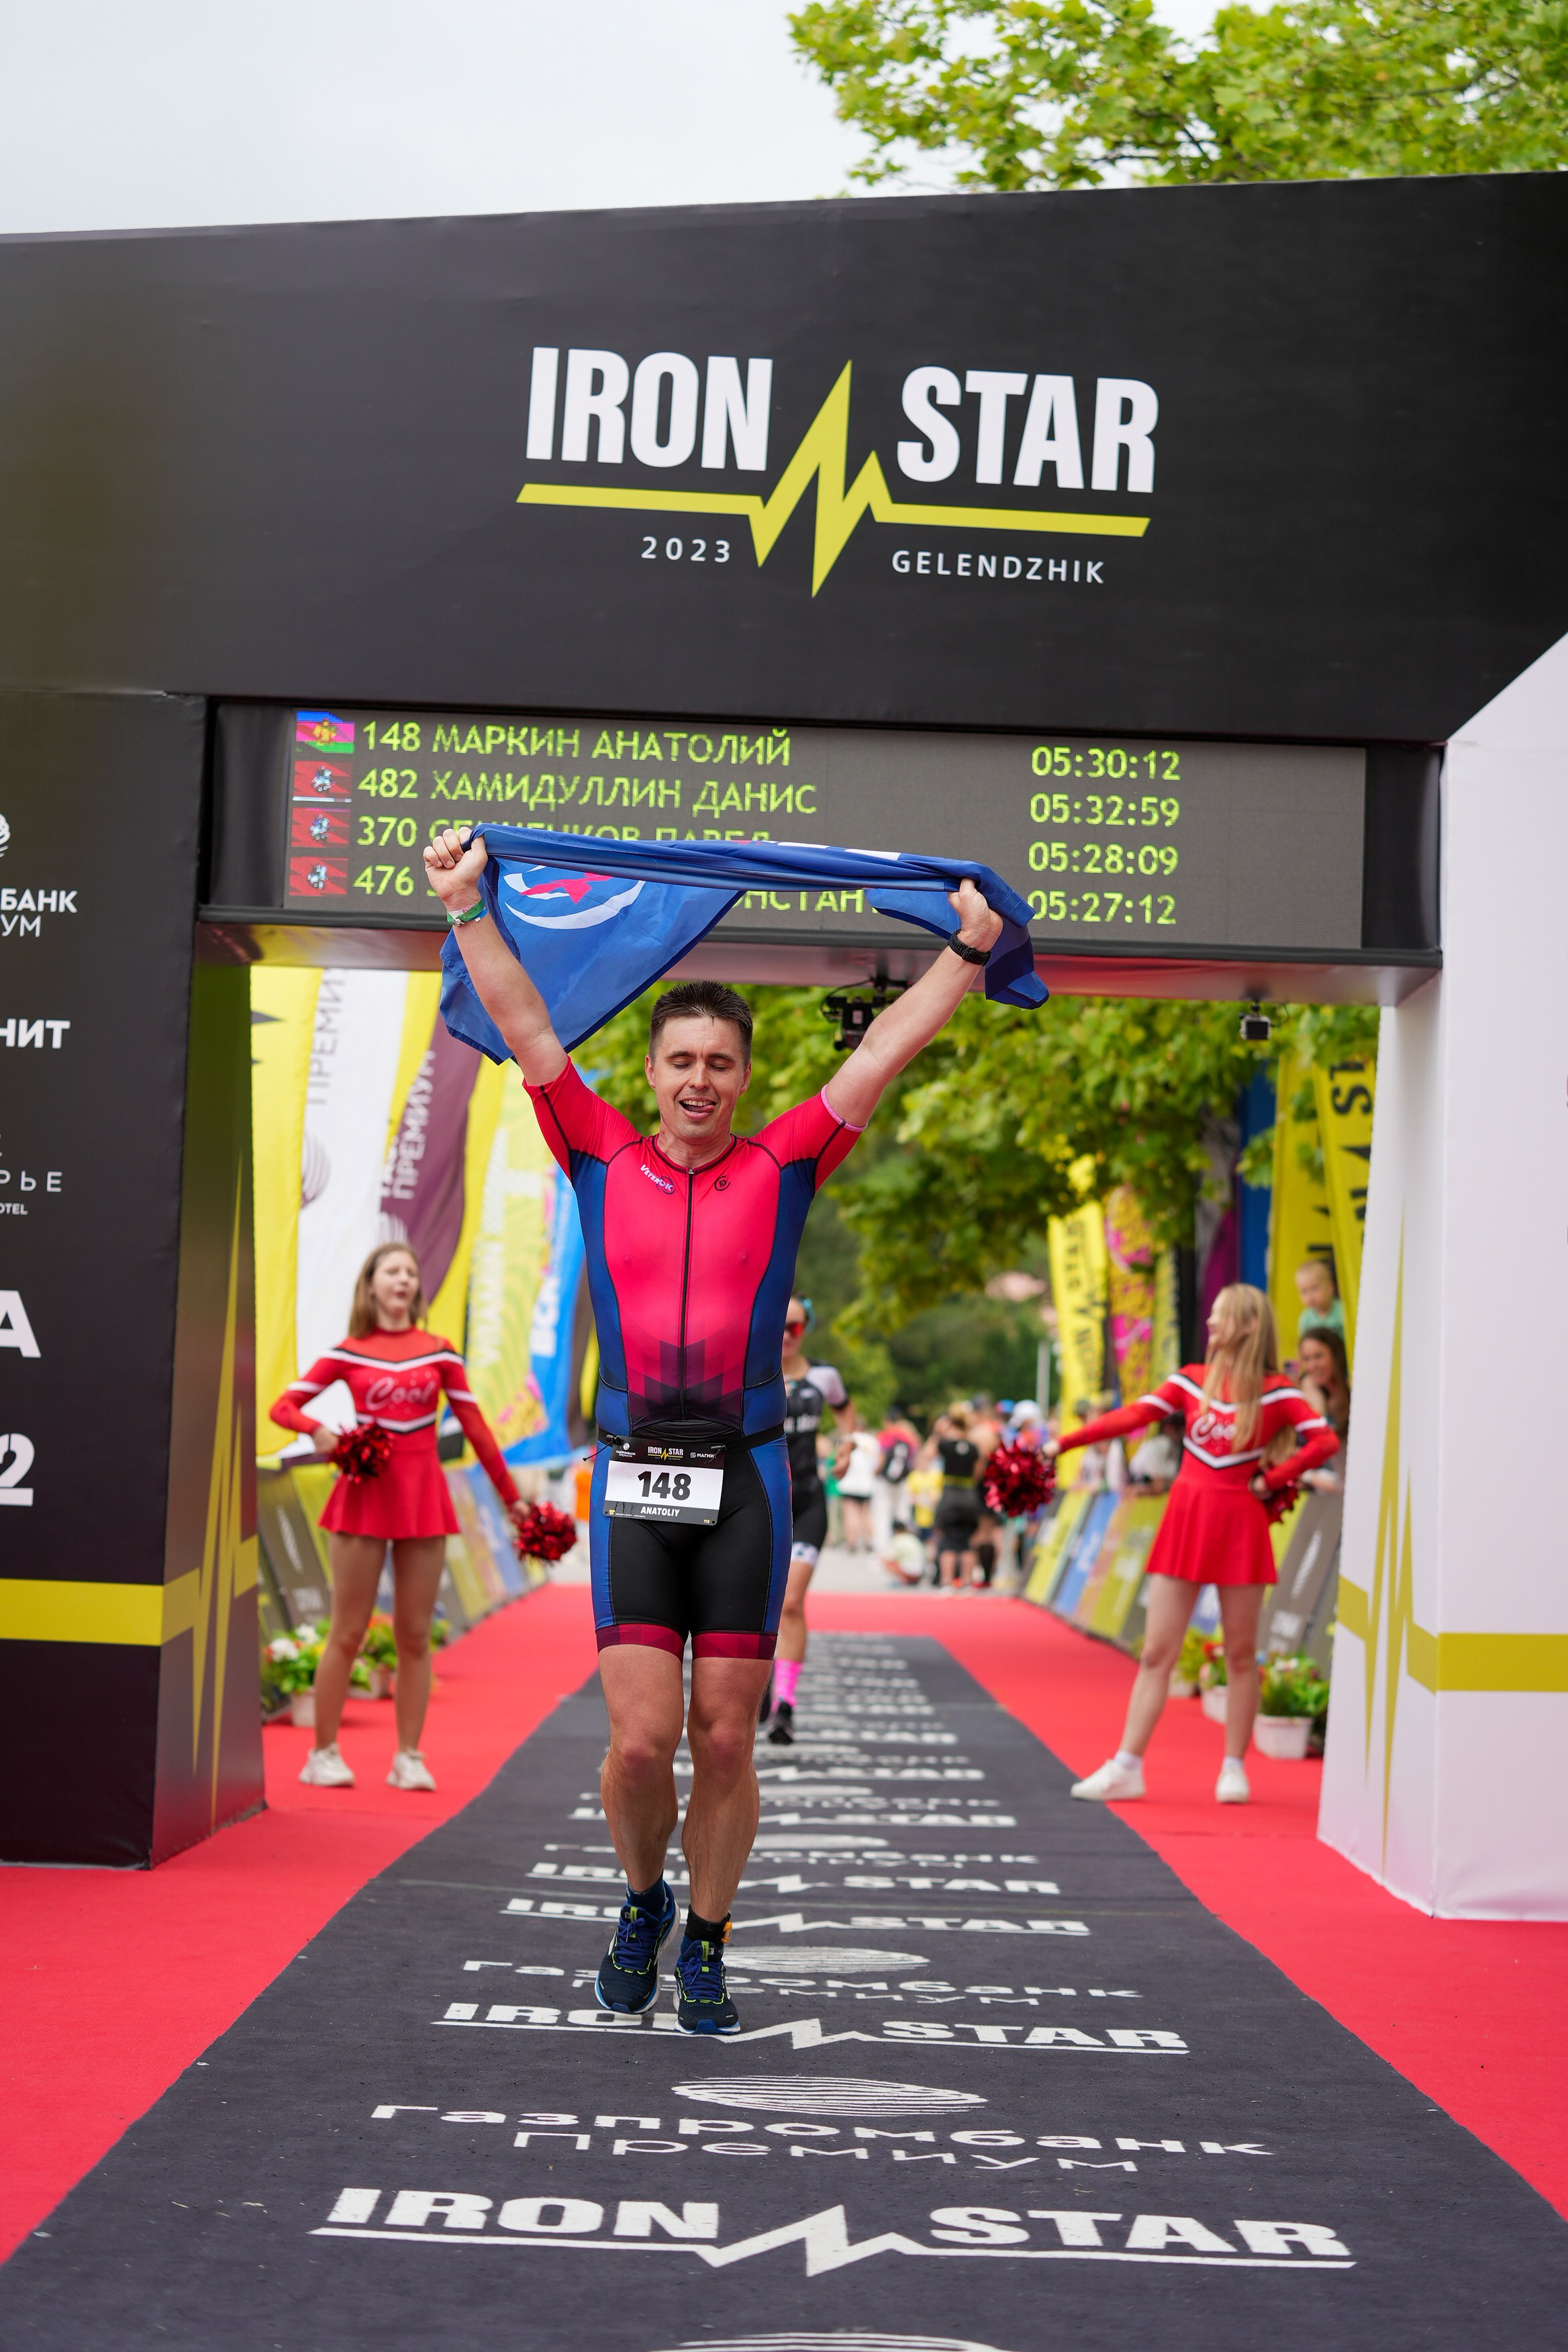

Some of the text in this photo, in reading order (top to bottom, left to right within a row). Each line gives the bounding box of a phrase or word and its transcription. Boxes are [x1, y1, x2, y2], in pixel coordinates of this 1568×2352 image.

[526, 346, 1160, 493] IRON STAR
[641, 536, 1105, 584] 2023 GELENDZHIK
[362, 721, 1181, 781] 148 МАРКИН АНАТОЛИЙ 05:30:12
[358, 768, 1181, 827] 482 ХАМИДУЛЛИН ДАНИС 05:32:59
[356, 816, 418, 848] 370
[1028, 841, 1179, 876] 05:28:09
[0, 887, 79, 914] БАНК
[353, 865, 414, 897] 476
[1026, 889, 1177, 926] 05:27:12
[0, 914, 42, 938] УМ
[365, 1376, 436, 1410] Cool
[648, 1446, 684, 1456] IRON STAR
[638, 1471, 691, 1501] 148
[640, 1506, 680, 1517] ANATOLIY
[844, 1876, 1061, 1895] STAR
[850, 1916, 1090, 1932] STAR
[882, 2020, 1189, 2049] STAR
[371, 2104, 1275, 2156] Газпромбанк
[513, 2131, 1138, 2172] Премиум
[326, 2188, 1352, 2256] IRON STAR
